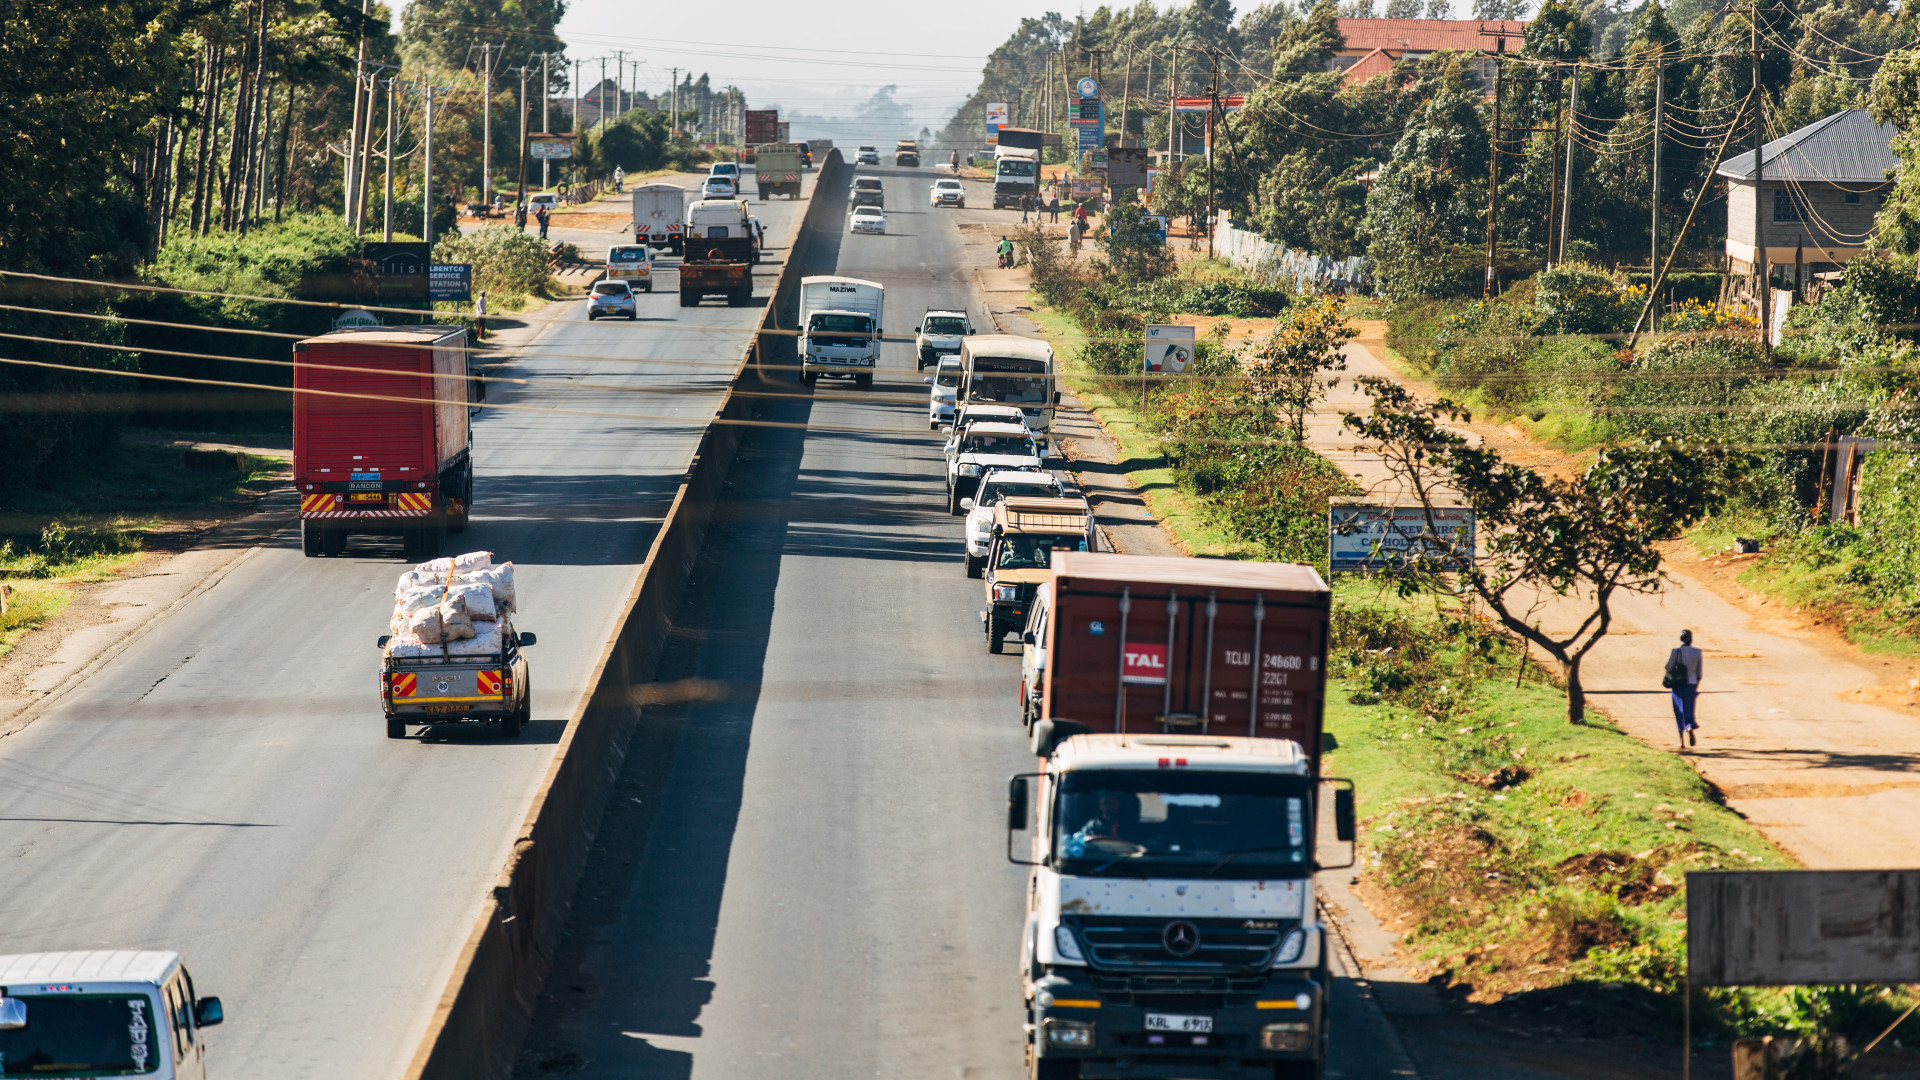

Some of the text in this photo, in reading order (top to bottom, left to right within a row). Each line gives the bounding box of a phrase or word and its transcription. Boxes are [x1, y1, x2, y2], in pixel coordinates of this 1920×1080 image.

[372, 262, 424, 274] ilisi
[429, 280, 461, 288] STATION
[1433, 513, 1464, 521] Nairobi
[1125, 652, 1165, 668] TAL
[1225, 650, 1251, 666] TCLU
[1263, 653, 1302, 670] 248600
[1262, 671, 1288, 685] 22G1
[1148, 1016, 1171, 1028] KBL
